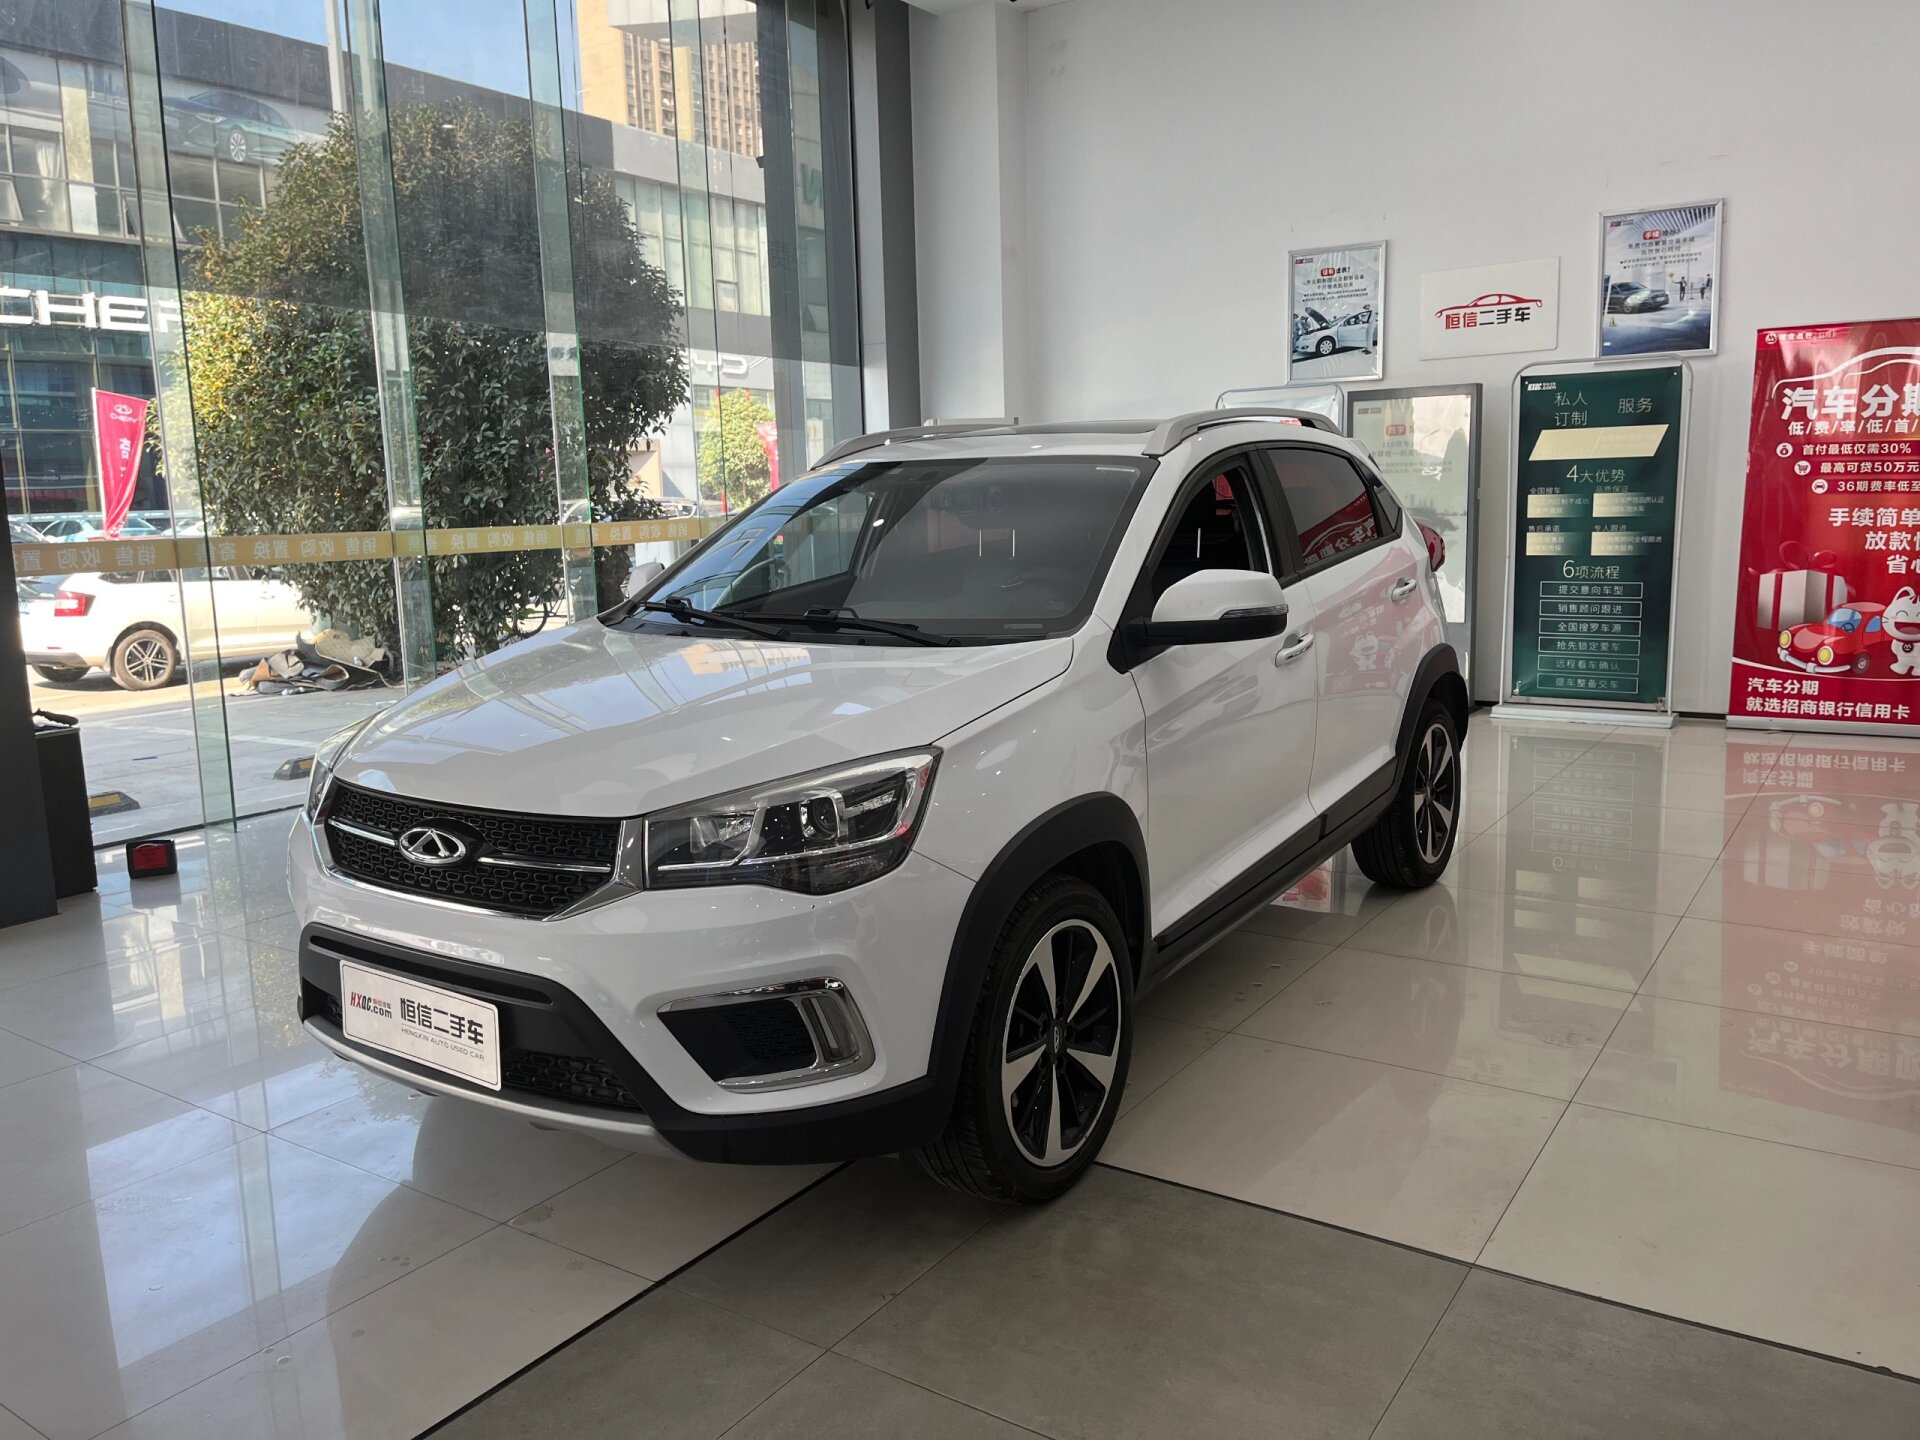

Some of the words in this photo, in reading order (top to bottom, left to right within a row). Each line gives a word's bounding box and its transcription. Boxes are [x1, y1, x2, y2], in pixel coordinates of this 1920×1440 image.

[1444, 307, 1531, 330] 恒信二手车
[1554, 391, 1588, 407] 私人
[1618, 397, 1653, 414] 服务
[1554, 410, 1588, 427] 订制
[1802, 443, 1912, 456] 首付最低仅需30%
[1566, 465, 1625, 483] 4大优势
[1820, 461, 1920, 474] 最高可贷50万元
[1837, 480, 1920, 493] 36期费率低至
[1828, 507, 1920, 527] 手续简单
[1562, 560, 1620, 579] 6项流程
[1558, 585, 1624, 595] 提交意向车型
[1558, 604, 1622, 614] 销售顾问跟进
[1557, 622, 1622, 633] 全国搜罗车源
[1556, 641, 1621, 651] 抢先锁定爱车
[1556, 660, 1620, 670] 远程看车确认
[1555, 678, 1620, 689] 提车整备交车
[1747, 677, 1819, 695] 汽车分期
[1746, 697, 1910, 719] 就选招商银行信用卡
[400, 997, 484, 1045] 恒信二手车
[401, 1027, 429, 1042] HENGXIN
[430, 1035, 449, 1049] AUTO
[450, 1043, 468, 1056] USED
[469, 1049, 485, 1062] CAR
